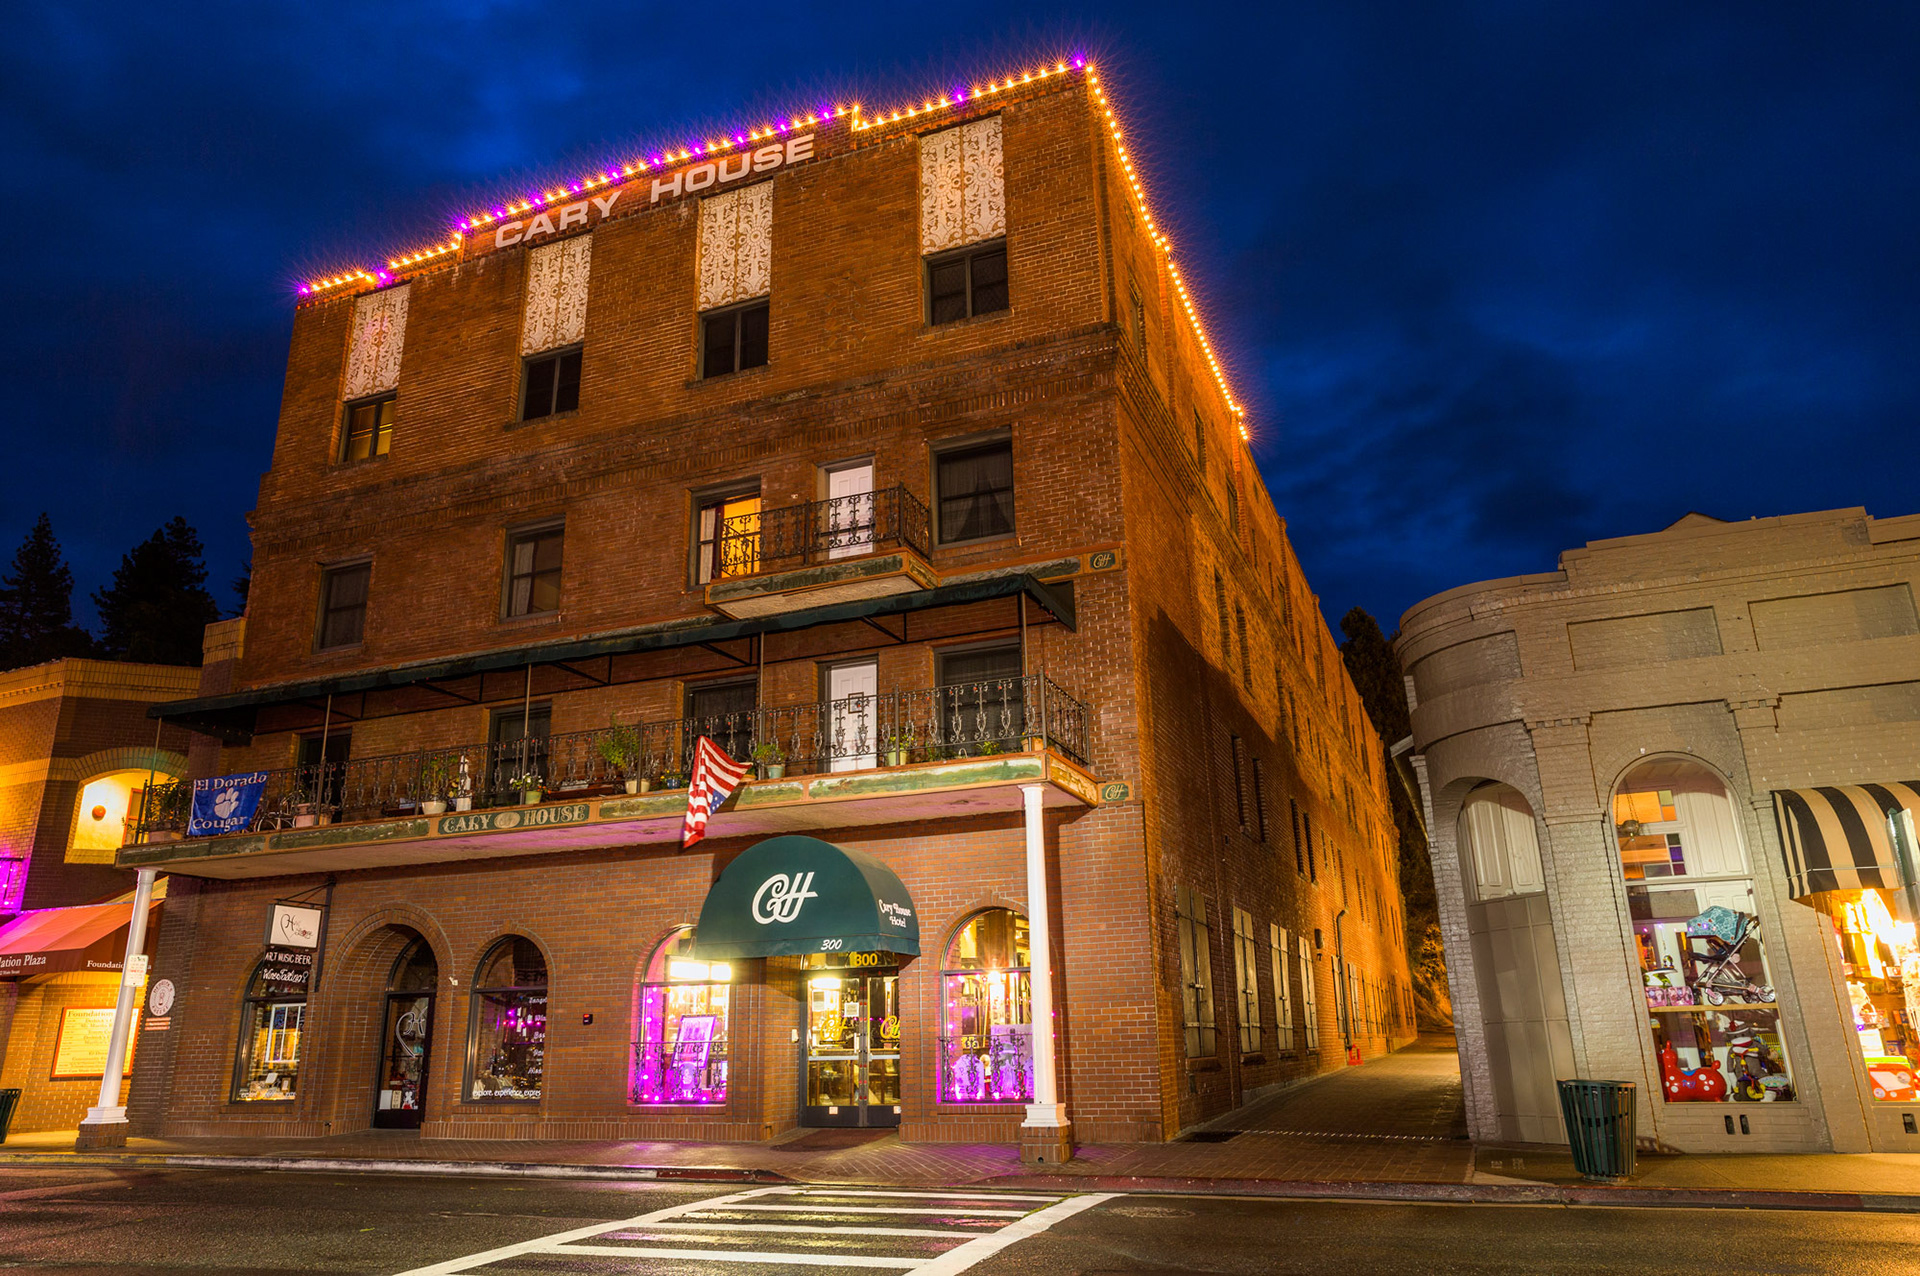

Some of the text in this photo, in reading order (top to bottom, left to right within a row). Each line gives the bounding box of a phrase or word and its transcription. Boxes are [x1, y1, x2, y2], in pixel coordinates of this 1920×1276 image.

[494, 133, 815, 249] CARY HOUSE
[197, 772, 267, 790] El Dorado
[193, 816, 247, 832] Cougar
[443, 814, 491, 833] CARY
[523, 804, 585, 825] HOUSE
[879, 899, 911, 916] Cary House
[889, 916, 906, 928] Hotel
[821, 939, 842, 950] 300
[23, 954, 46, 966] Plaza
[86, 960, 125, 969] Foundatio
[265, 952, 311, 965] ART MUSIC BEER
